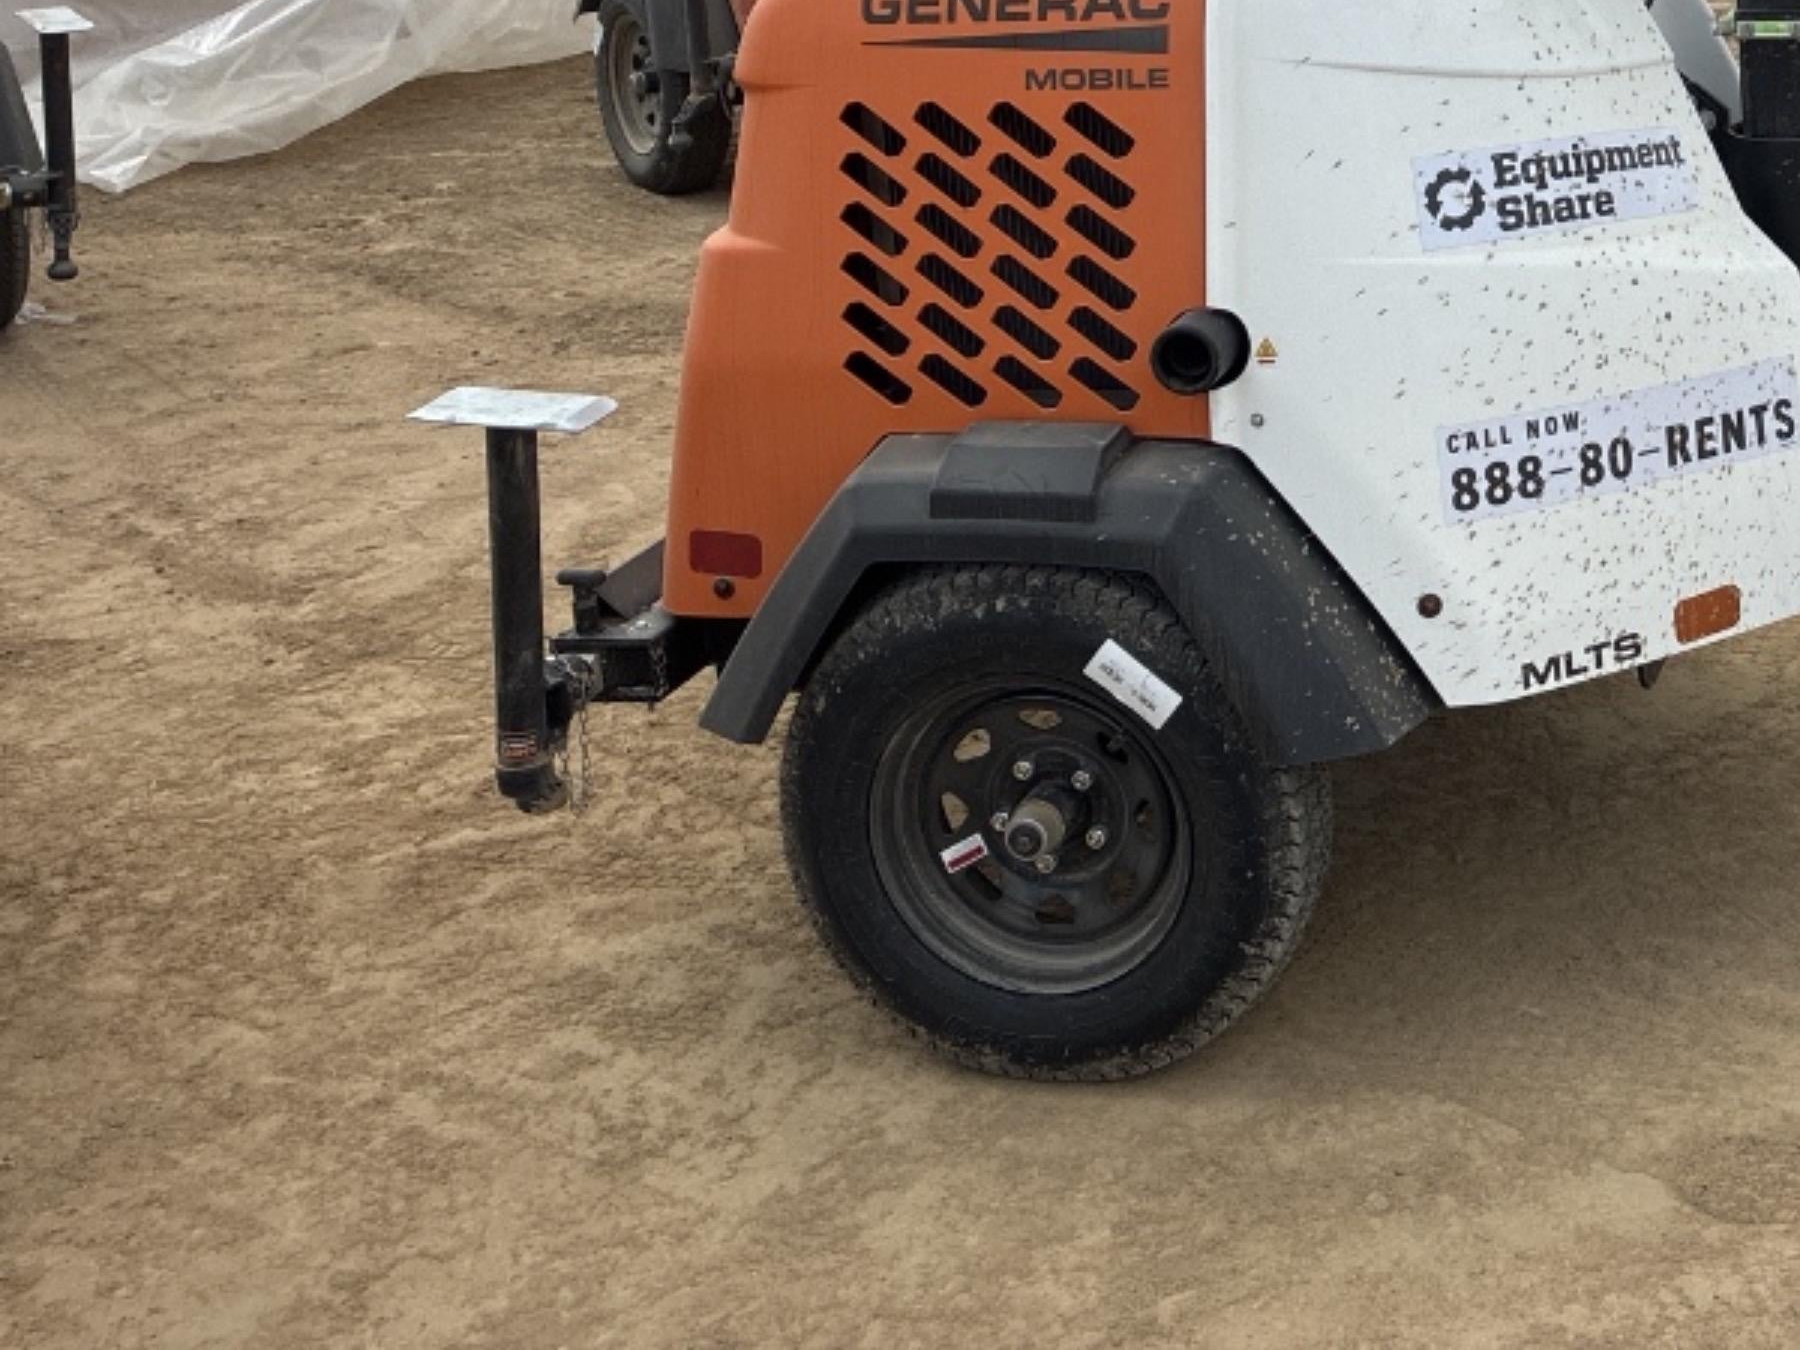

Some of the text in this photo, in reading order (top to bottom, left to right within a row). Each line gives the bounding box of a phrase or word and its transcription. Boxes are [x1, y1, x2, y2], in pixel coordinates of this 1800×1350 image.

[1024, 68, 1169, 91] MOBILE
[1490, 135, 1685, 191] Equipment
[1496, 189, 1616, 232] Share
[1446, 411, 1580, 454] CALL NOW
[1450, 398, 1796, 512] 888-80-RENTS
[1520, 632, 1642, 690] MLTS
